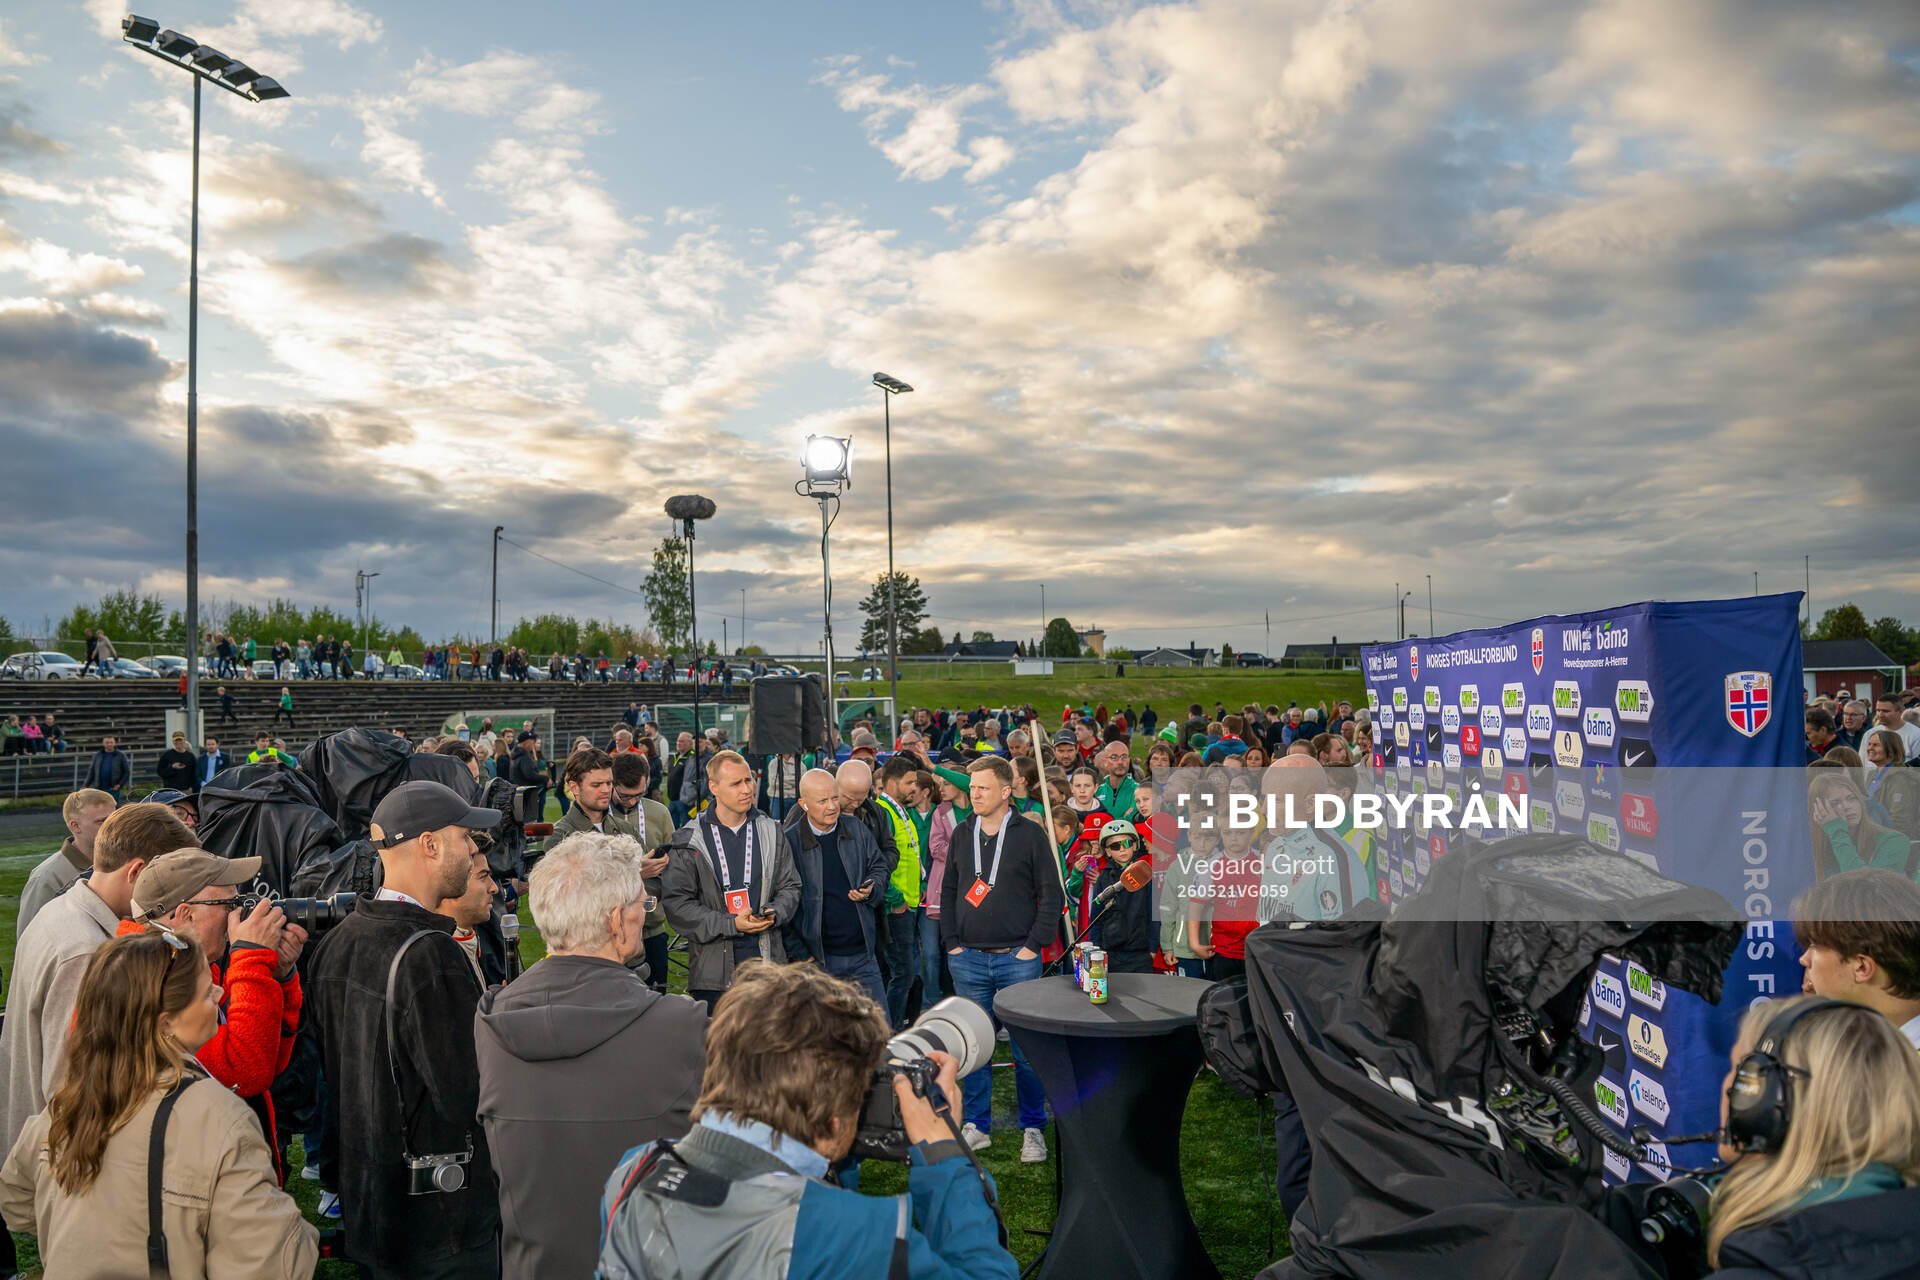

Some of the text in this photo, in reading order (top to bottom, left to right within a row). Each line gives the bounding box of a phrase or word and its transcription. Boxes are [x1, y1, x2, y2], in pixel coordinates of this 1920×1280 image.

[1563, 630, 1582, 651] KIWI
[1597, 625, 1629, 650] bama
[1426, 644, 1518, 669] NORGES FOTBALLFORBUND
[1563, 658, 1604, 670] Hovedsponsorer
[1555, 688, 1571, 709] KIWI
[1619, 688, 1640, 713] KIWI
[1443, 709, 1458, 727] bama
[1483, 711, 1500, 729] bama
[1529, 711, 1550, 731] bama
[1587, 713, 1612, 737] bama
[1463, 743, 1478, 753] VIKING
[1558, 752, 1579, 767] Gjensidige
[1590, 819, 1609, 846] KIWI
[1626, 816, 1651, 833] VIKING
[1741, 810, 1776, 961] NORGES
[1595, 975, 1622, 1009] bama
[1629, 966, 1652, 998] KIWI
[1651, 990, 1661, 1002] pris
[1632, 1039, 1661, 1063] Gjensidige
[1596, 1080, 1625, 1114] KIWI mini
[1641, 1087, 1667, 1112] telenor
[1616, 1107, 1625, 1119] pris
